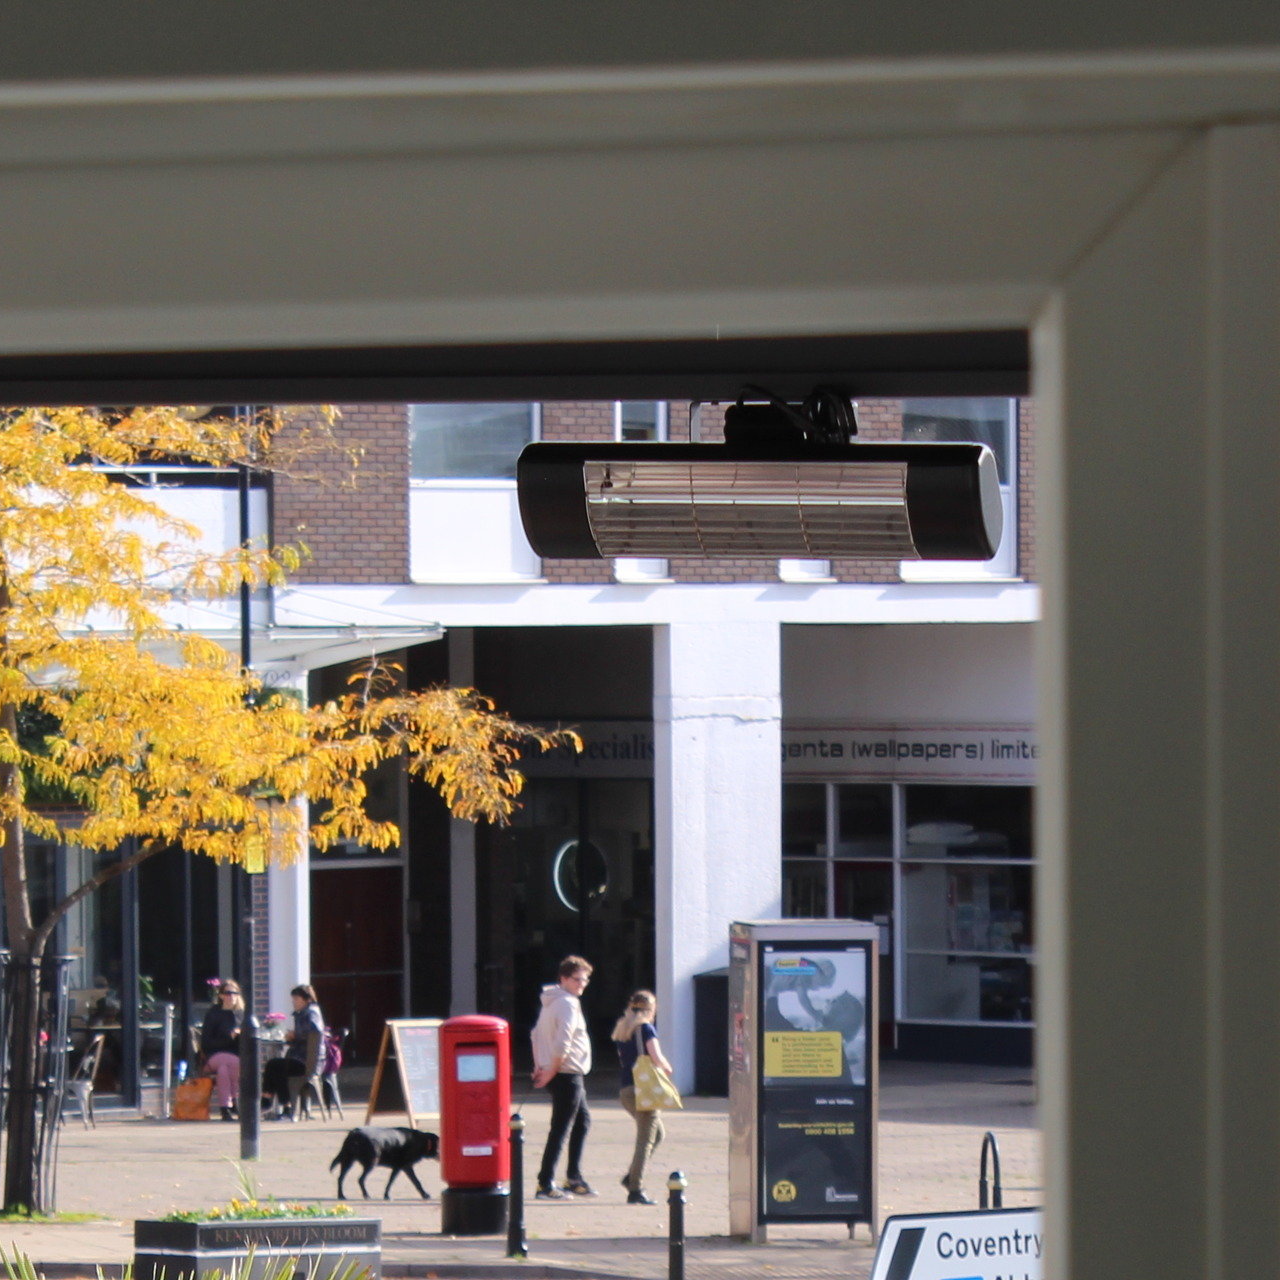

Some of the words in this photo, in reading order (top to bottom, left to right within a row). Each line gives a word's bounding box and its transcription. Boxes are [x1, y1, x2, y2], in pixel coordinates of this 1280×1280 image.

[851, 738, 984, 763] (wallpapers)
[323, 1225, 367, 1240] BLOOM
[937, 1228, 1043, 1260] Coventry
